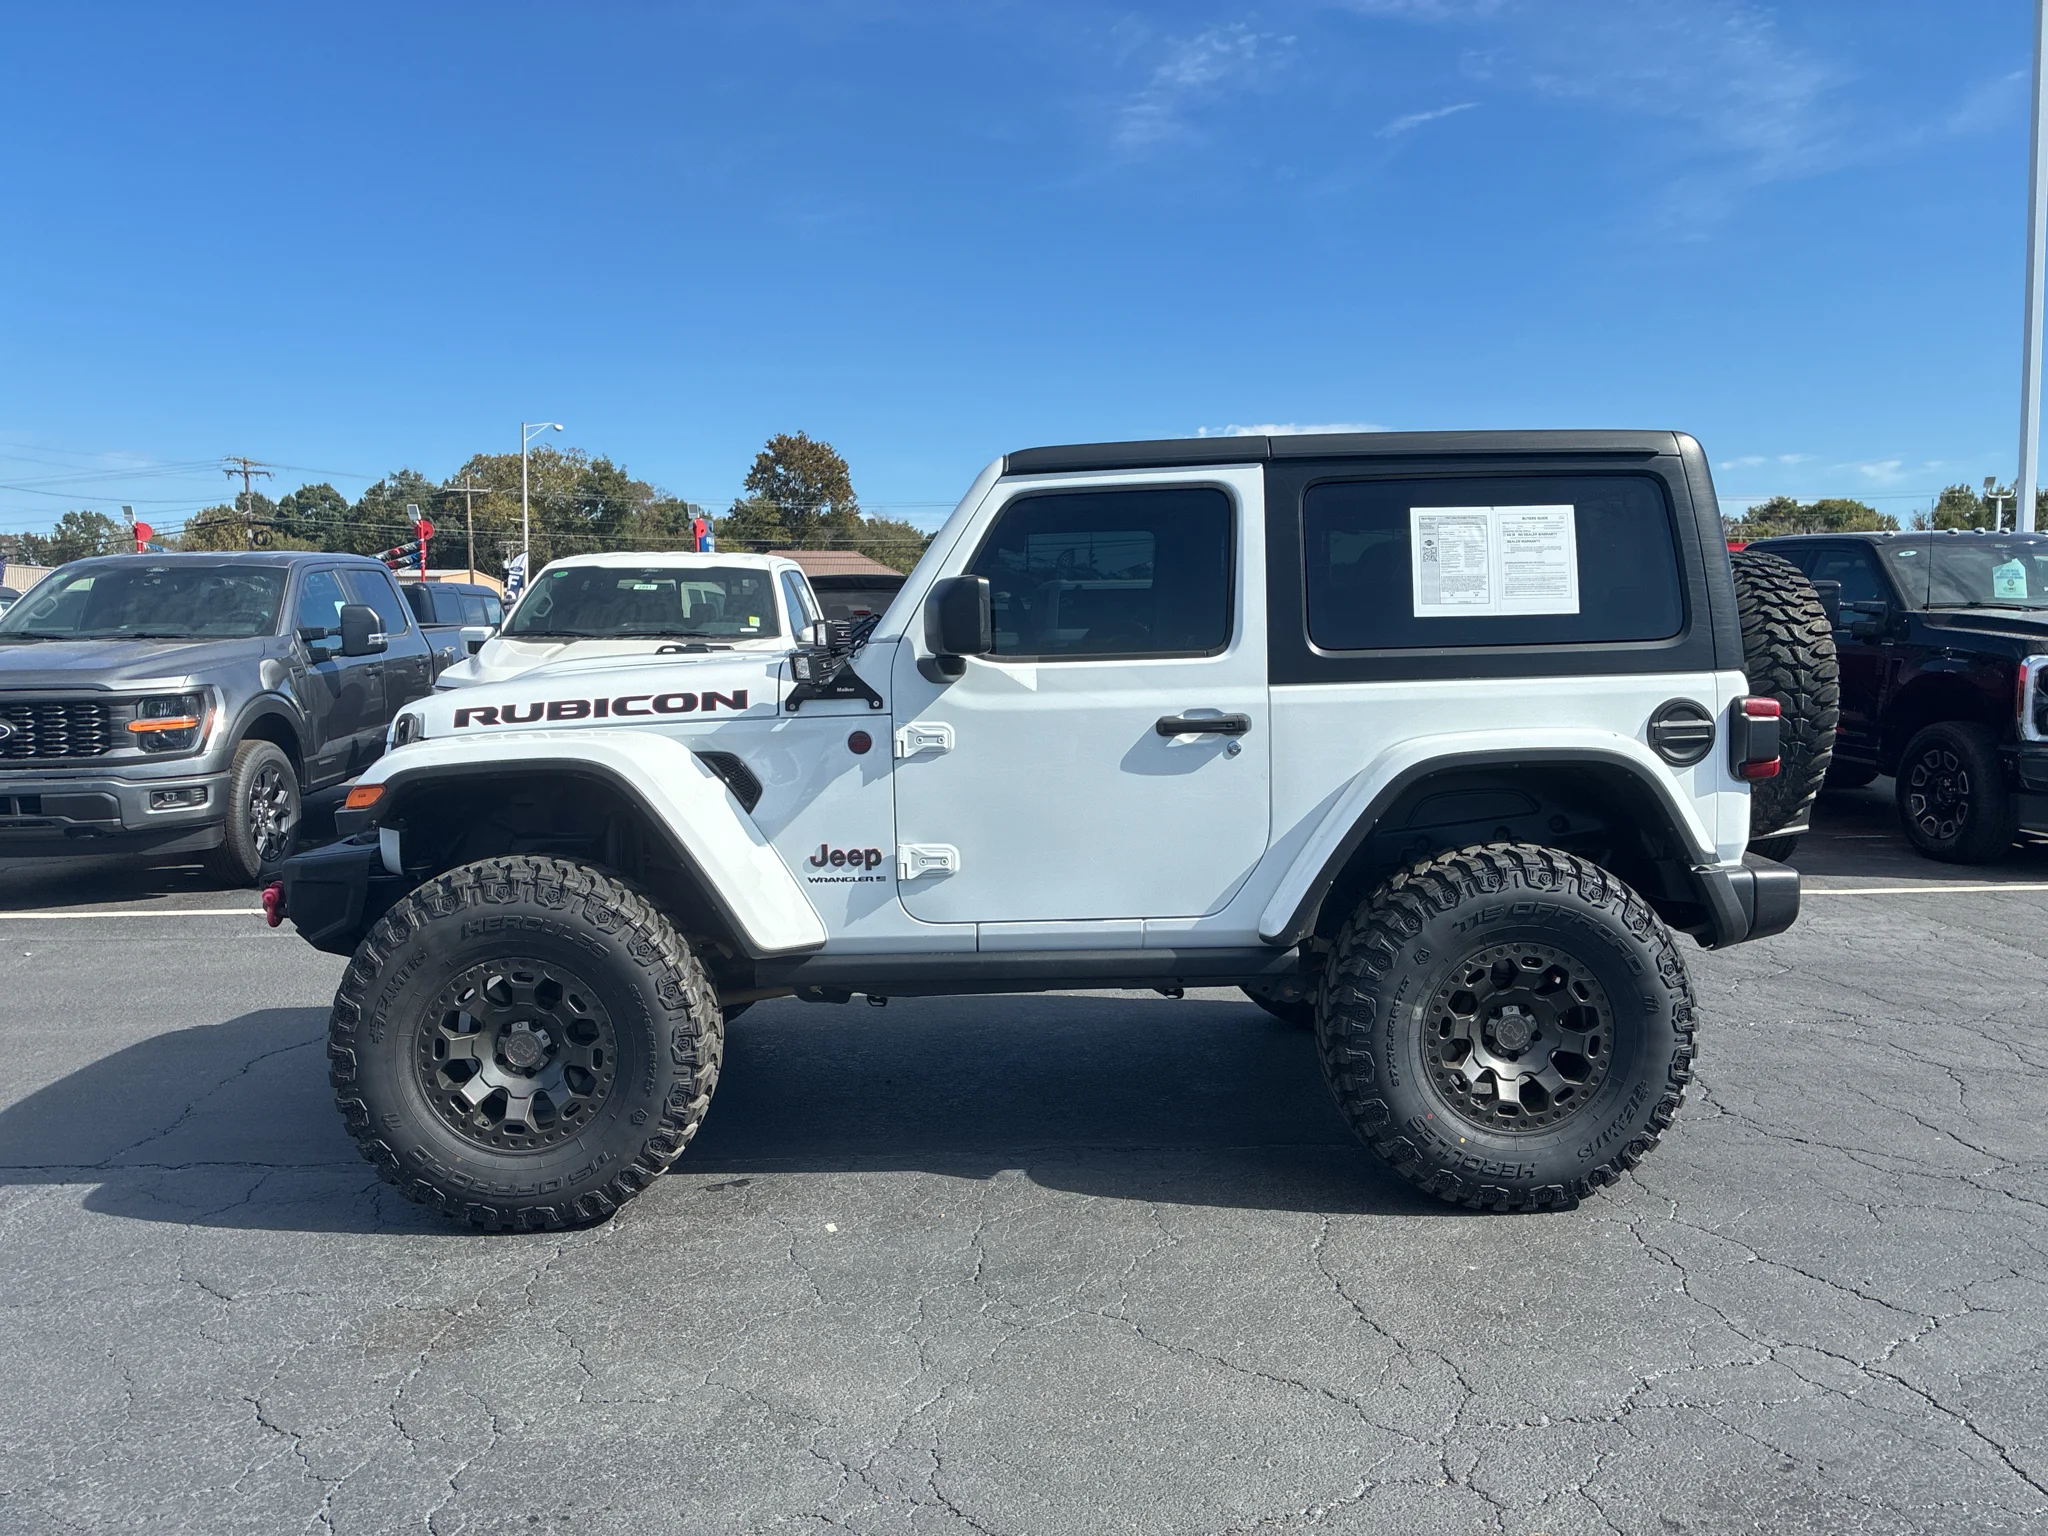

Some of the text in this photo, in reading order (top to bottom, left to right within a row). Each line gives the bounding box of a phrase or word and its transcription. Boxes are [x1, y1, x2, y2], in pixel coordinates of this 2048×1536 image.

[453, 689, 748, 728] RUBICON
[809, 843, 882, 871] Jeep
[461, 915, 611, 960] HERCULES
[1511, 901, 1647, 976] OFFROAD
[406, 1144, 564, 1198] OFFROAD
[1404, 1114, 1539, 1180] HERCULES
